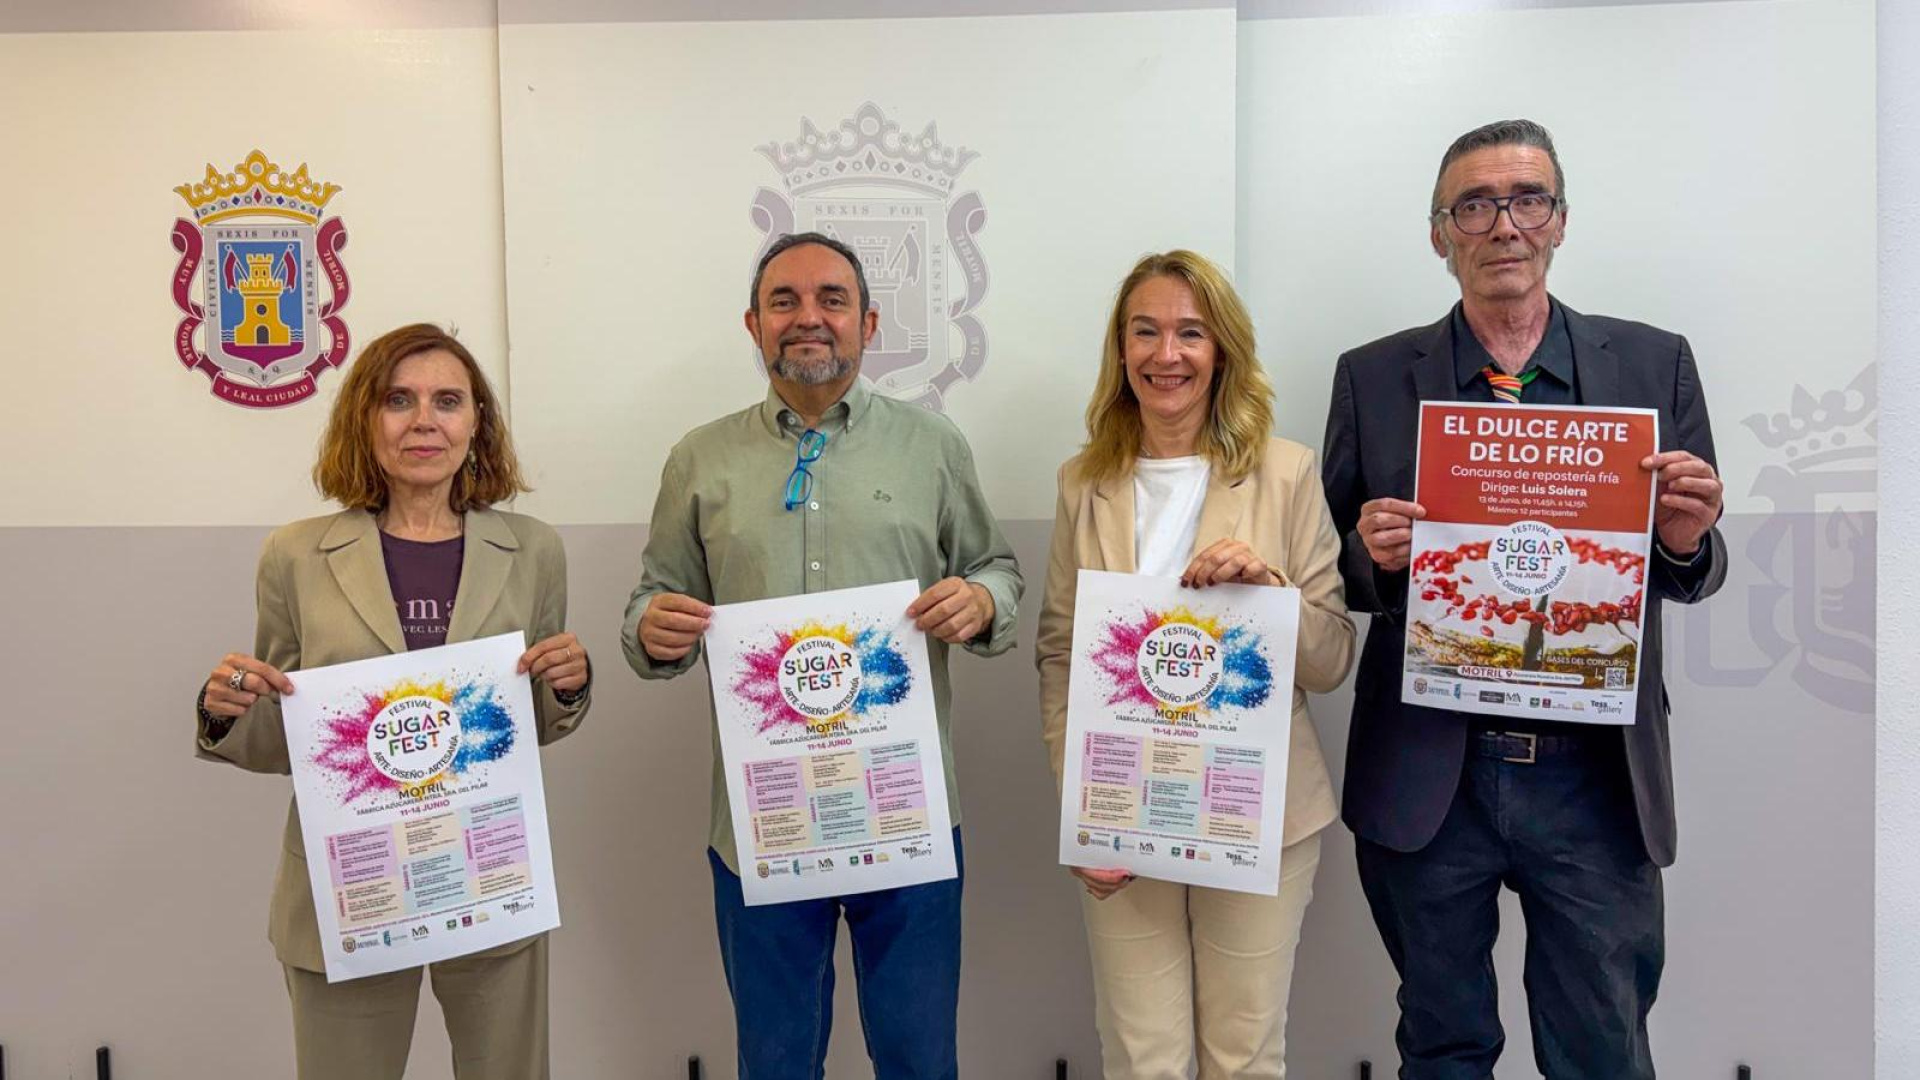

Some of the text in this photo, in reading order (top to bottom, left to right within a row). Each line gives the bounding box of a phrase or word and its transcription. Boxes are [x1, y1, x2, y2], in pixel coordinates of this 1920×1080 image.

[217, 230, 258, 239] SEXIS
[179, 258, 195, 285] MUY
[323, 249, 346, 291] MOTRIL
[208, 259, 217, 318] CIVITAS
[180, 323, 194, 362] NOBLE
[222, 384, 308, 403] Y LEAL CIUDAD
[1444, 415, 1629, 442] EL DULCE ARTE
[1470, 441, 1604, 466] DE LO FRÍO
[1451, 465, 1620, 484] Concurso de repostería fría
[1481, 481, 1588, 497] Dirige: Luis Solera
[1512, 523, 1551, 536] FESTIVAL
[1496, 537, 1565, 556] SUGAR
[1505, 555, 1553, 571] FEST
[1162, 626, 1203, 640] FESTIVAL
[796, 640, 836, 655] FESTIVAL
[1146, 640, 1216, 661] SUGAR
[784, 652, 853, 676] SUGAR
[1155, 658, 1204, 678] FEST
[1461, 666, 1503, 678] MOTRIL
[1587, 658, 1630, 667] CONCURSO
[797, 671, 843, 692] FEST
[1141, 664, 1154, 685] ARTE
[1152, 684, 1182, 703] DISEÑO
[388, 700, 433, 716] FESTIVAL
[784, 686, 799, 706] ARTE
[799, 702, 829, 716] DISEÑO
[1154, 708, 1199, 722] MOTRIL
[374, 710, 451, 740] SUGAR
[805, 720, 849, 735] MOTRIL
[1173, 728, 1199, 738] JUNIO
[388, 730, 440, 756] FEST
[827, 738, 853, 749] JUNIO
[373, 750, 391, 771] ARTE
[390, 767, 425, 779] DISEÑO
[398, 782, 447, 800] MOTRIL
[422, 799, 451, 812] JUNIO
